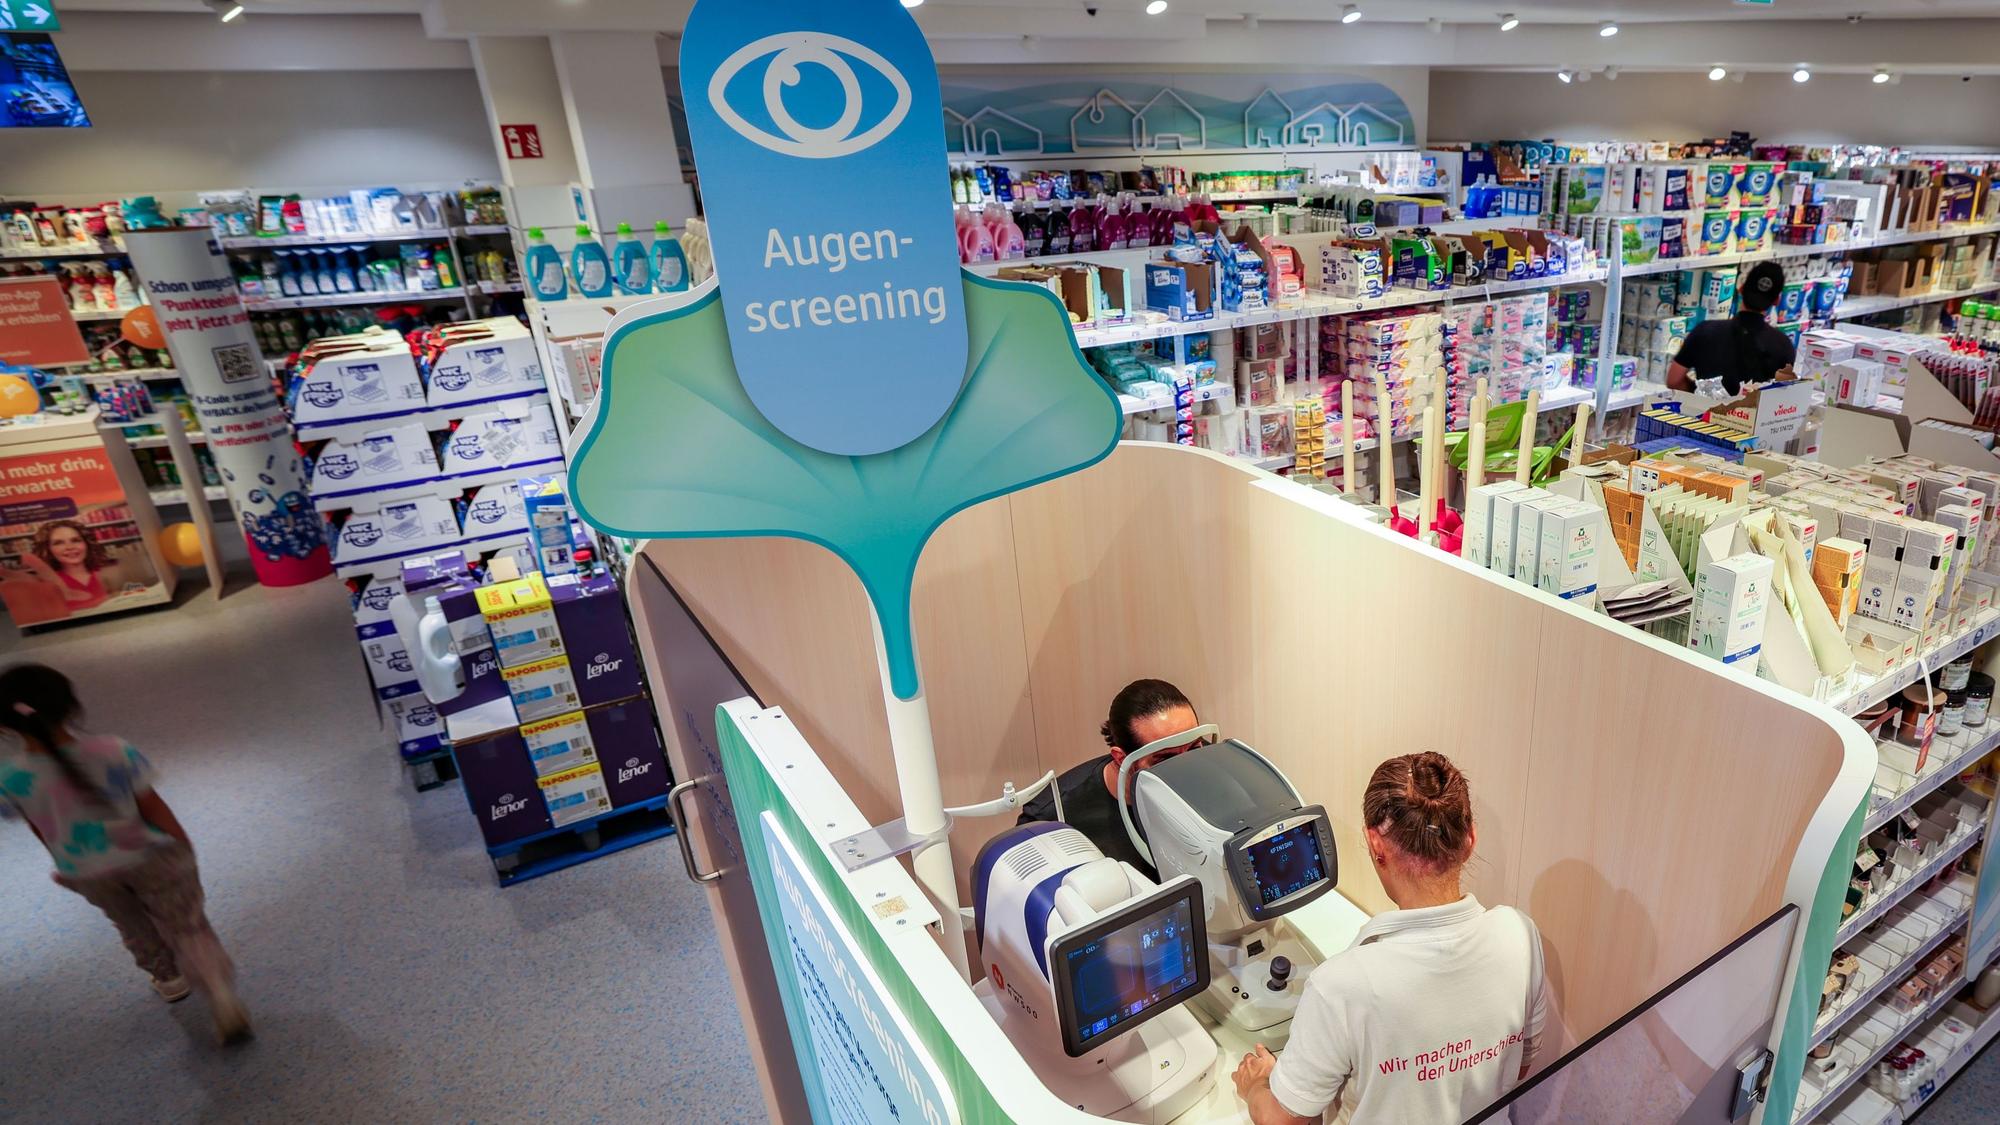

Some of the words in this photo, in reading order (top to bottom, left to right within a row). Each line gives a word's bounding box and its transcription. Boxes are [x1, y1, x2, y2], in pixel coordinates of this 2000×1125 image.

[764, 228, 913, 273] Augen-
[149, 279, 189, 293] Schon
[745, 281, 946, 333] screening
[1774, 405, 1797, 416] vileda
[8, 462, 57, 478] mehr
[586, 659, 623, 680] Lenor
[617, 762, 653, 784] Lenor
[491, 798, 528, 822] Lenor
[1379, 1057, 1408, 1075] Wir
[1415, 1039, 1472, 1067] machen
[1417, 1064, 1445, 1082] den
